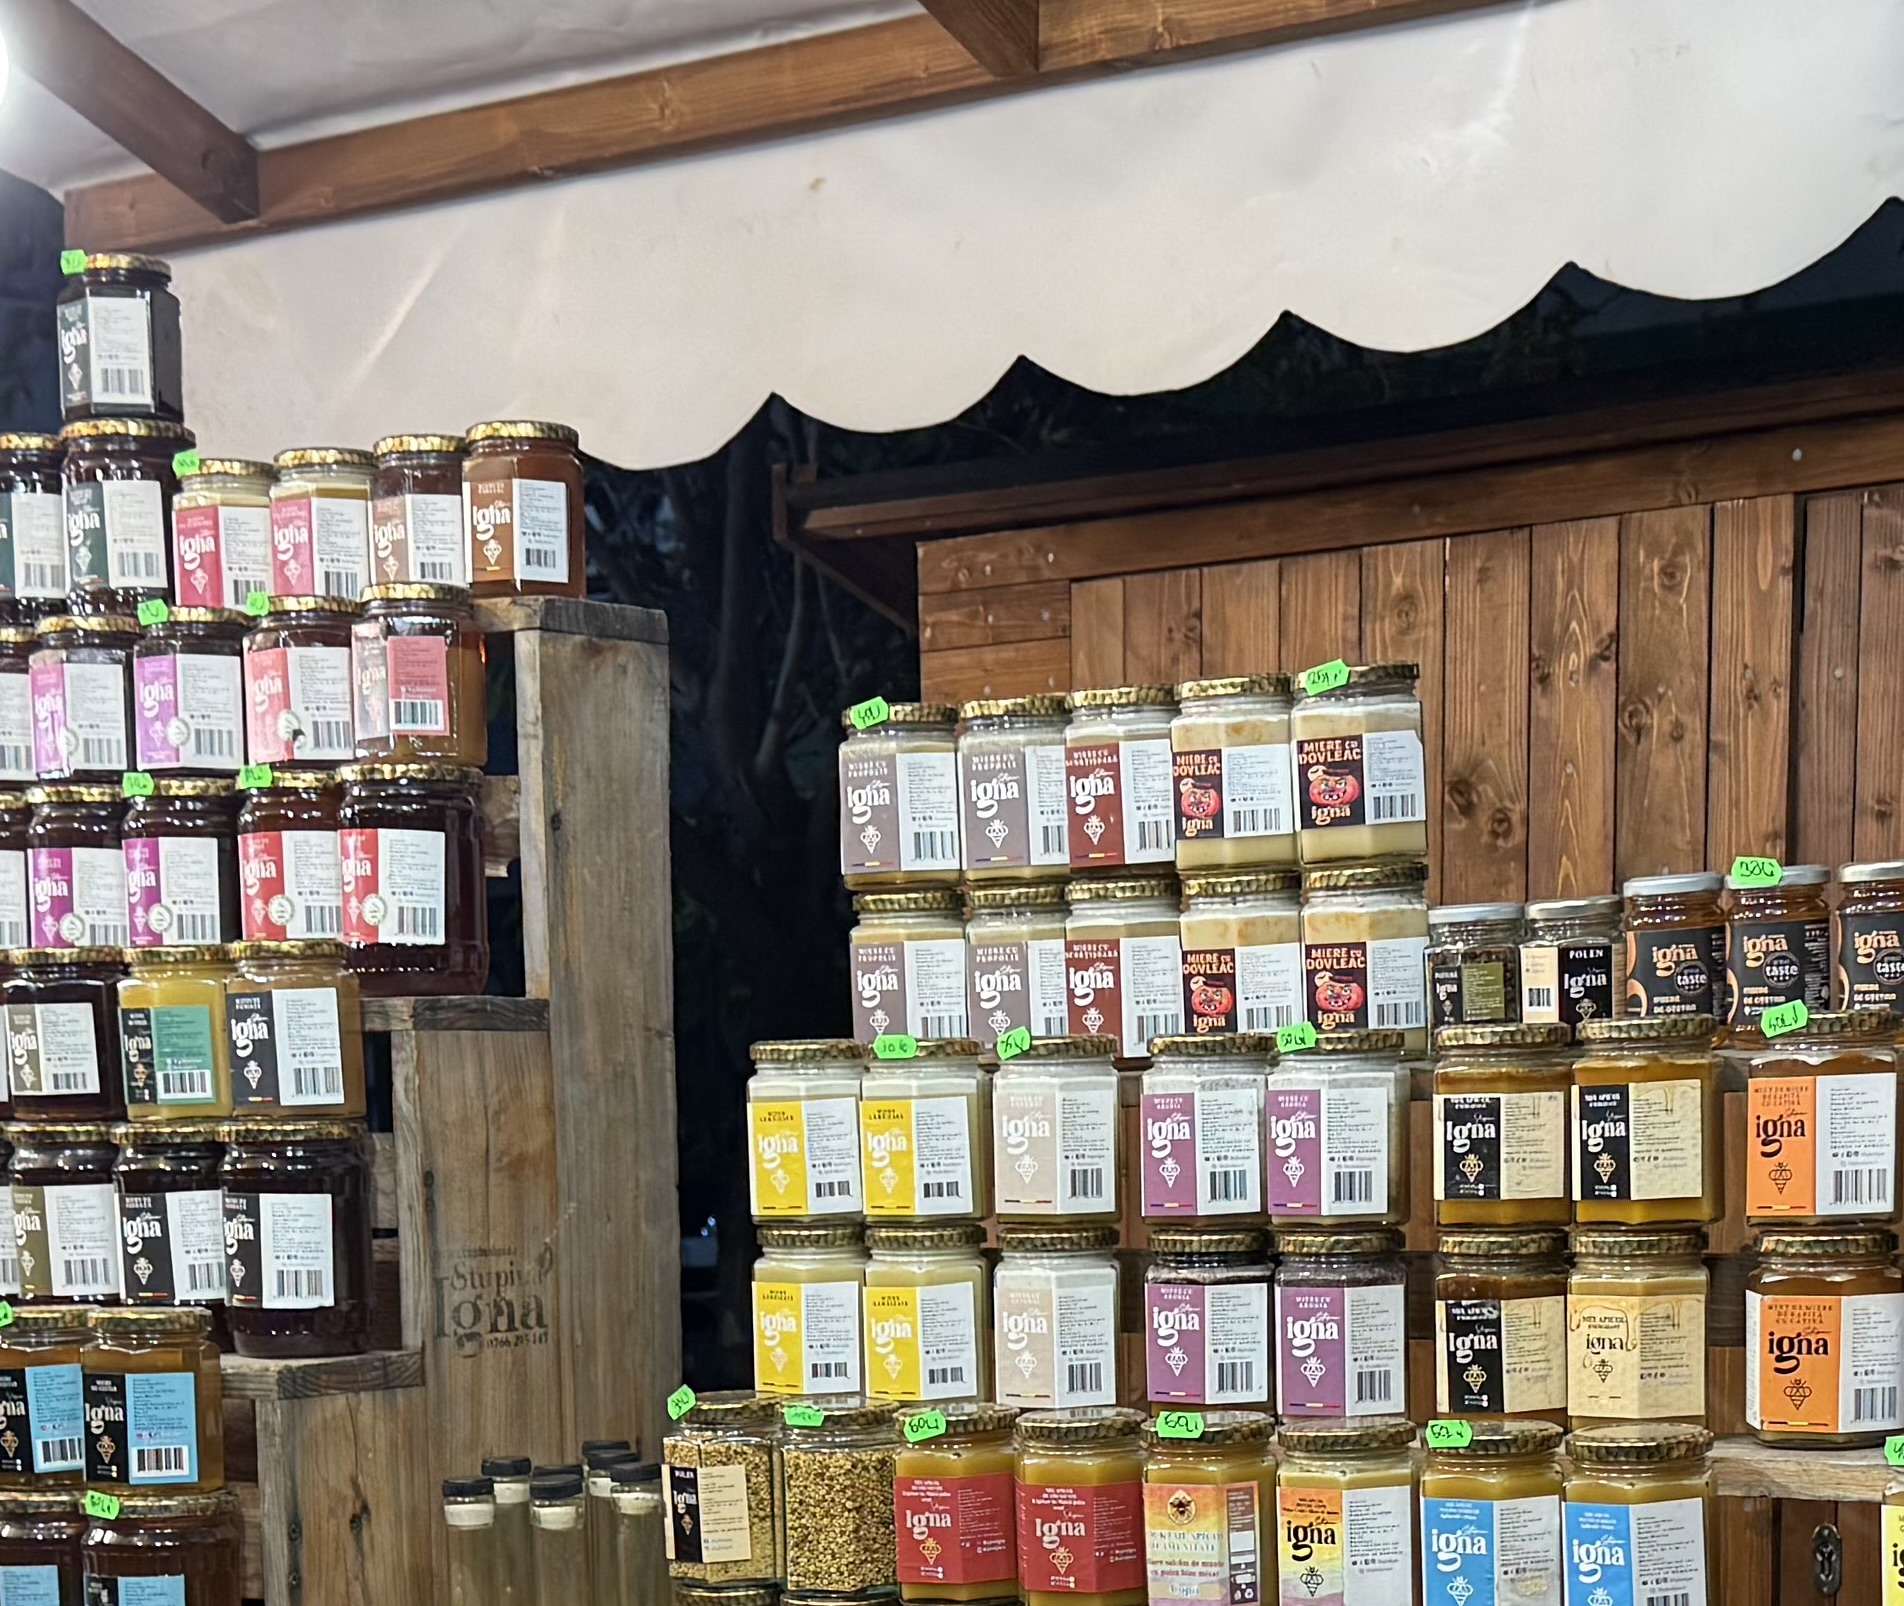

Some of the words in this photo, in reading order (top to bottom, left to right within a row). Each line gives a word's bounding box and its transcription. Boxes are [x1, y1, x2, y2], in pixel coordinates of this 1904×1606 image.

[1298, 749, 1361, 764] DOVLEAC
[1303, 740, 1342, 753] MIERE
[847, 786, 890, 824] igna
[970, 780, 1019, 818] igna
[1070, 776, 1114, 814] igna
[1182, 817, 1212, 836] igna
[1312, 806, 1350, 825] igna
[1306, 958, 1366, 970] DOVLEAC
[1312, 948, 1348, 958] MIERE
[1569, 948, 1603, 959] POLEN
[1652, 945, 1698, 976] igna
[1743, 934, 1788, 968] igna
[1854, 931, 1900, 965] igna
[1069, 968, 1114, 1006] igna
[1676, 973, 1708, 987] taste
[1765, 964, 1799, 976] taste
[857, 970, 898, 1008] igna
[975, 971, 1022, 1009] igna
[1194, 1015, 1226, 1034] igna
[1318, 1011, 1354, 1030] igna
[1147, 1118, 1190, 1158] igna
[1756, 1115, 1805, 1158] igna
[1768, 1331, 1828, 1374] igna
[1286, 1520, 1336, 1561] igna
[1432, 1530, 1488, 1571] igna
